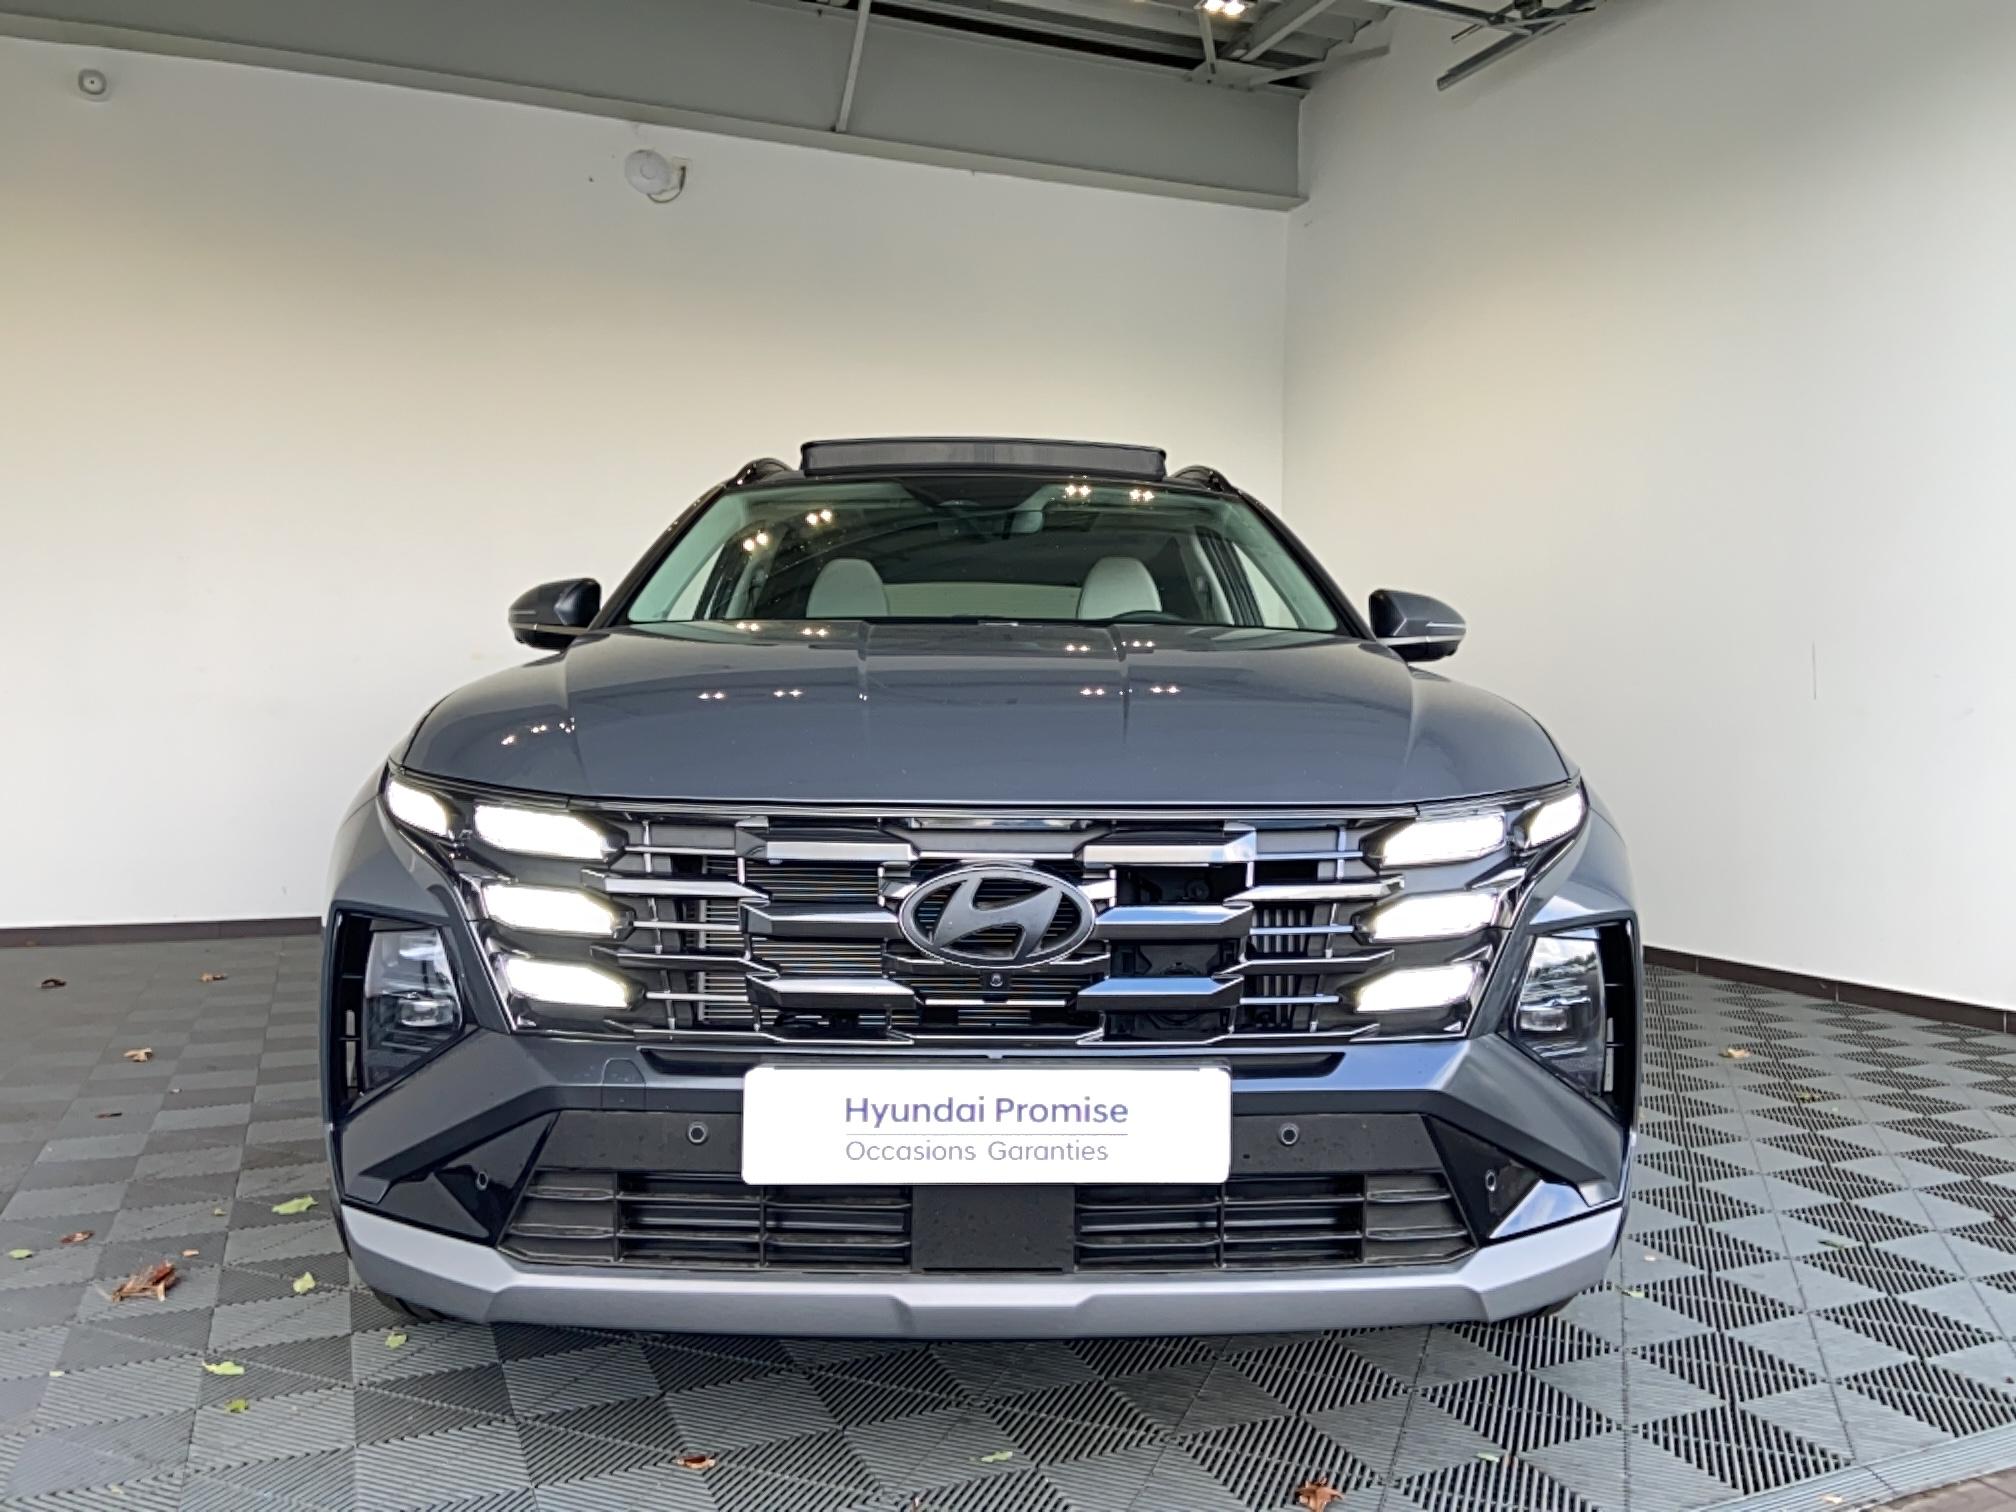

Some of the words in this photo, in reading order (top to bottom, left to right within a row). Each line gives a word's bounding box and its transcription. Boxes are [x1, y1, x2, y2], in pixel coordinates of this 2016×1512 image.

[845, 1096, 985, 1129] Hyundai
[995, 1095, 1129, 1124] Promise
[845, 1139, 977, 1161] Occasions
[987, 1139, 1109, 1161] Garanties
